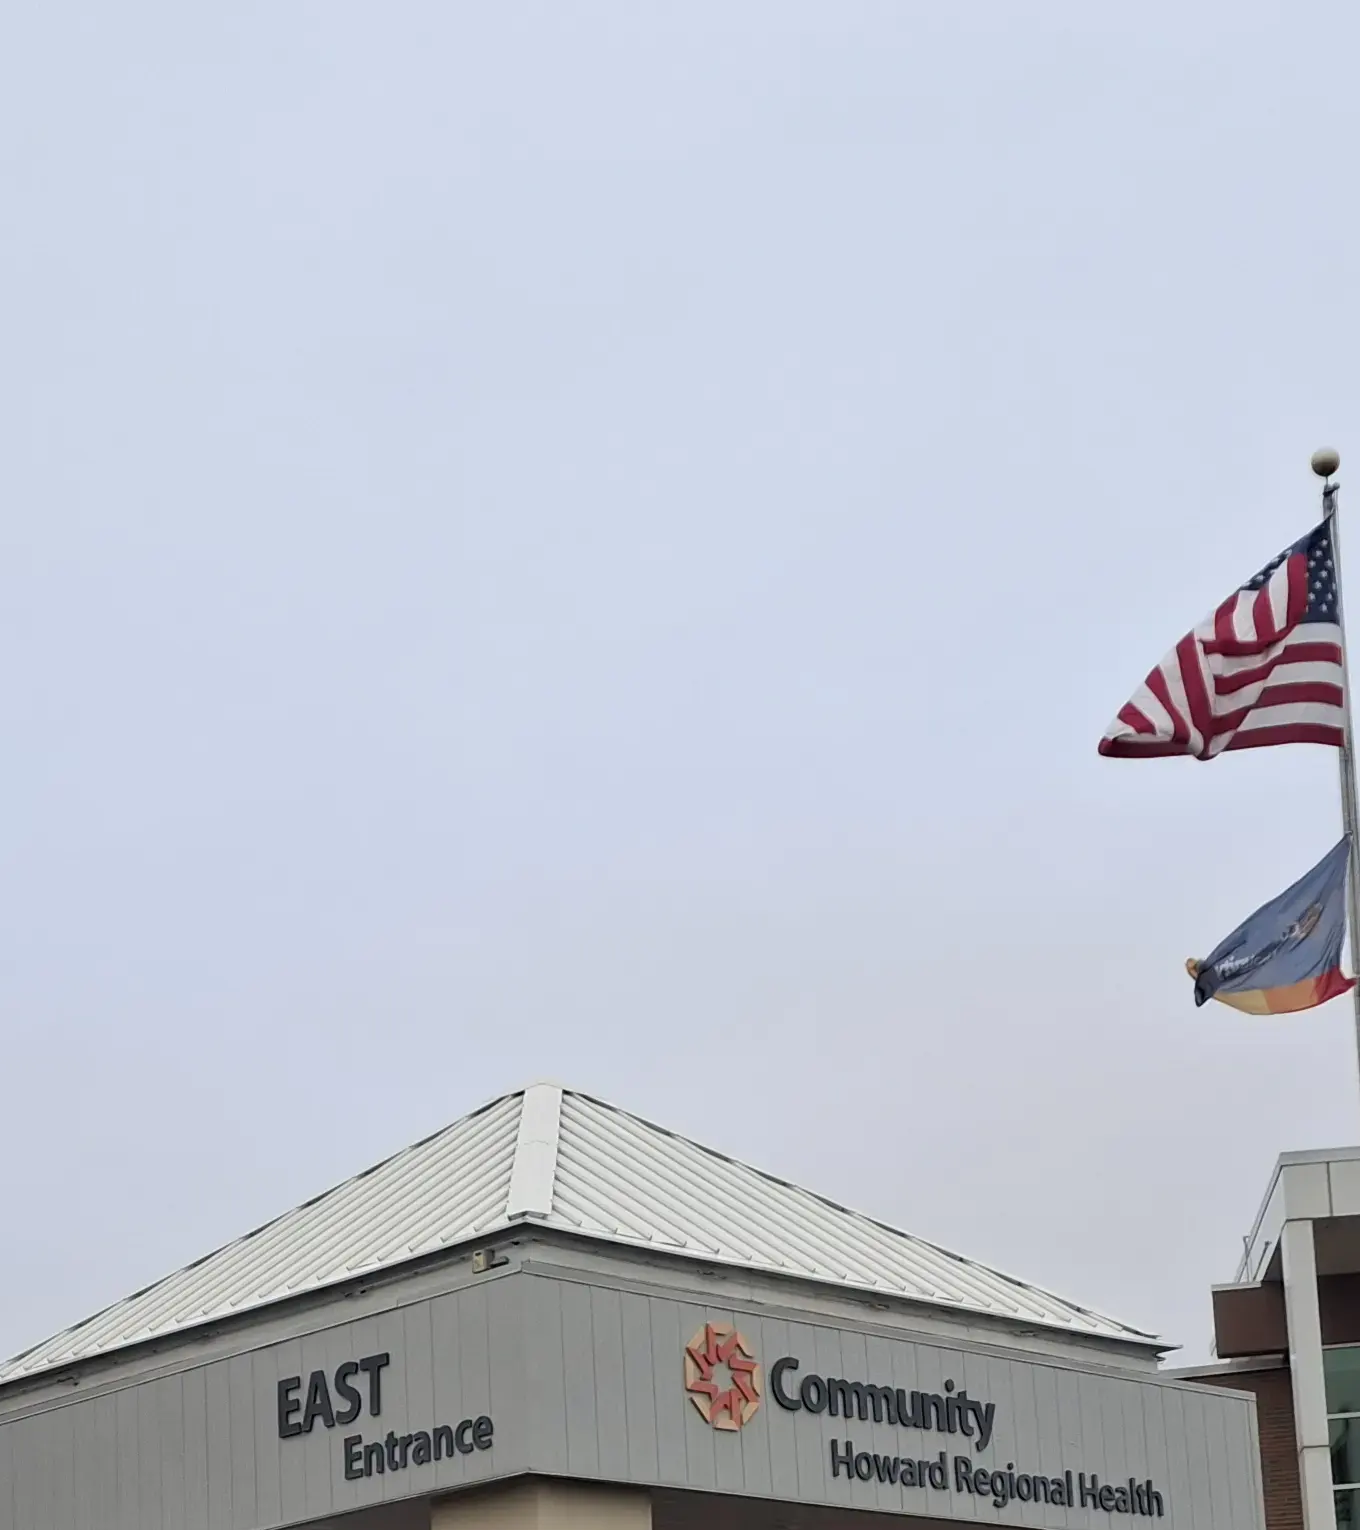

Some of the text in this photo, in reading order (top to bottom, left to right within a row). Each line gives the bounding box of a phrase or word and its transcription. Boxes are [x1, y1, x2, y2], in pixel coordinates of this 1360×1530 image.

[277, 1352, 390, 1438] EAST
[770, 1356, 996, 1452] Community
[343, 1415, 494, 1480] Entrance
[830, 1438, 1165, 1517] Howard Regional Health
